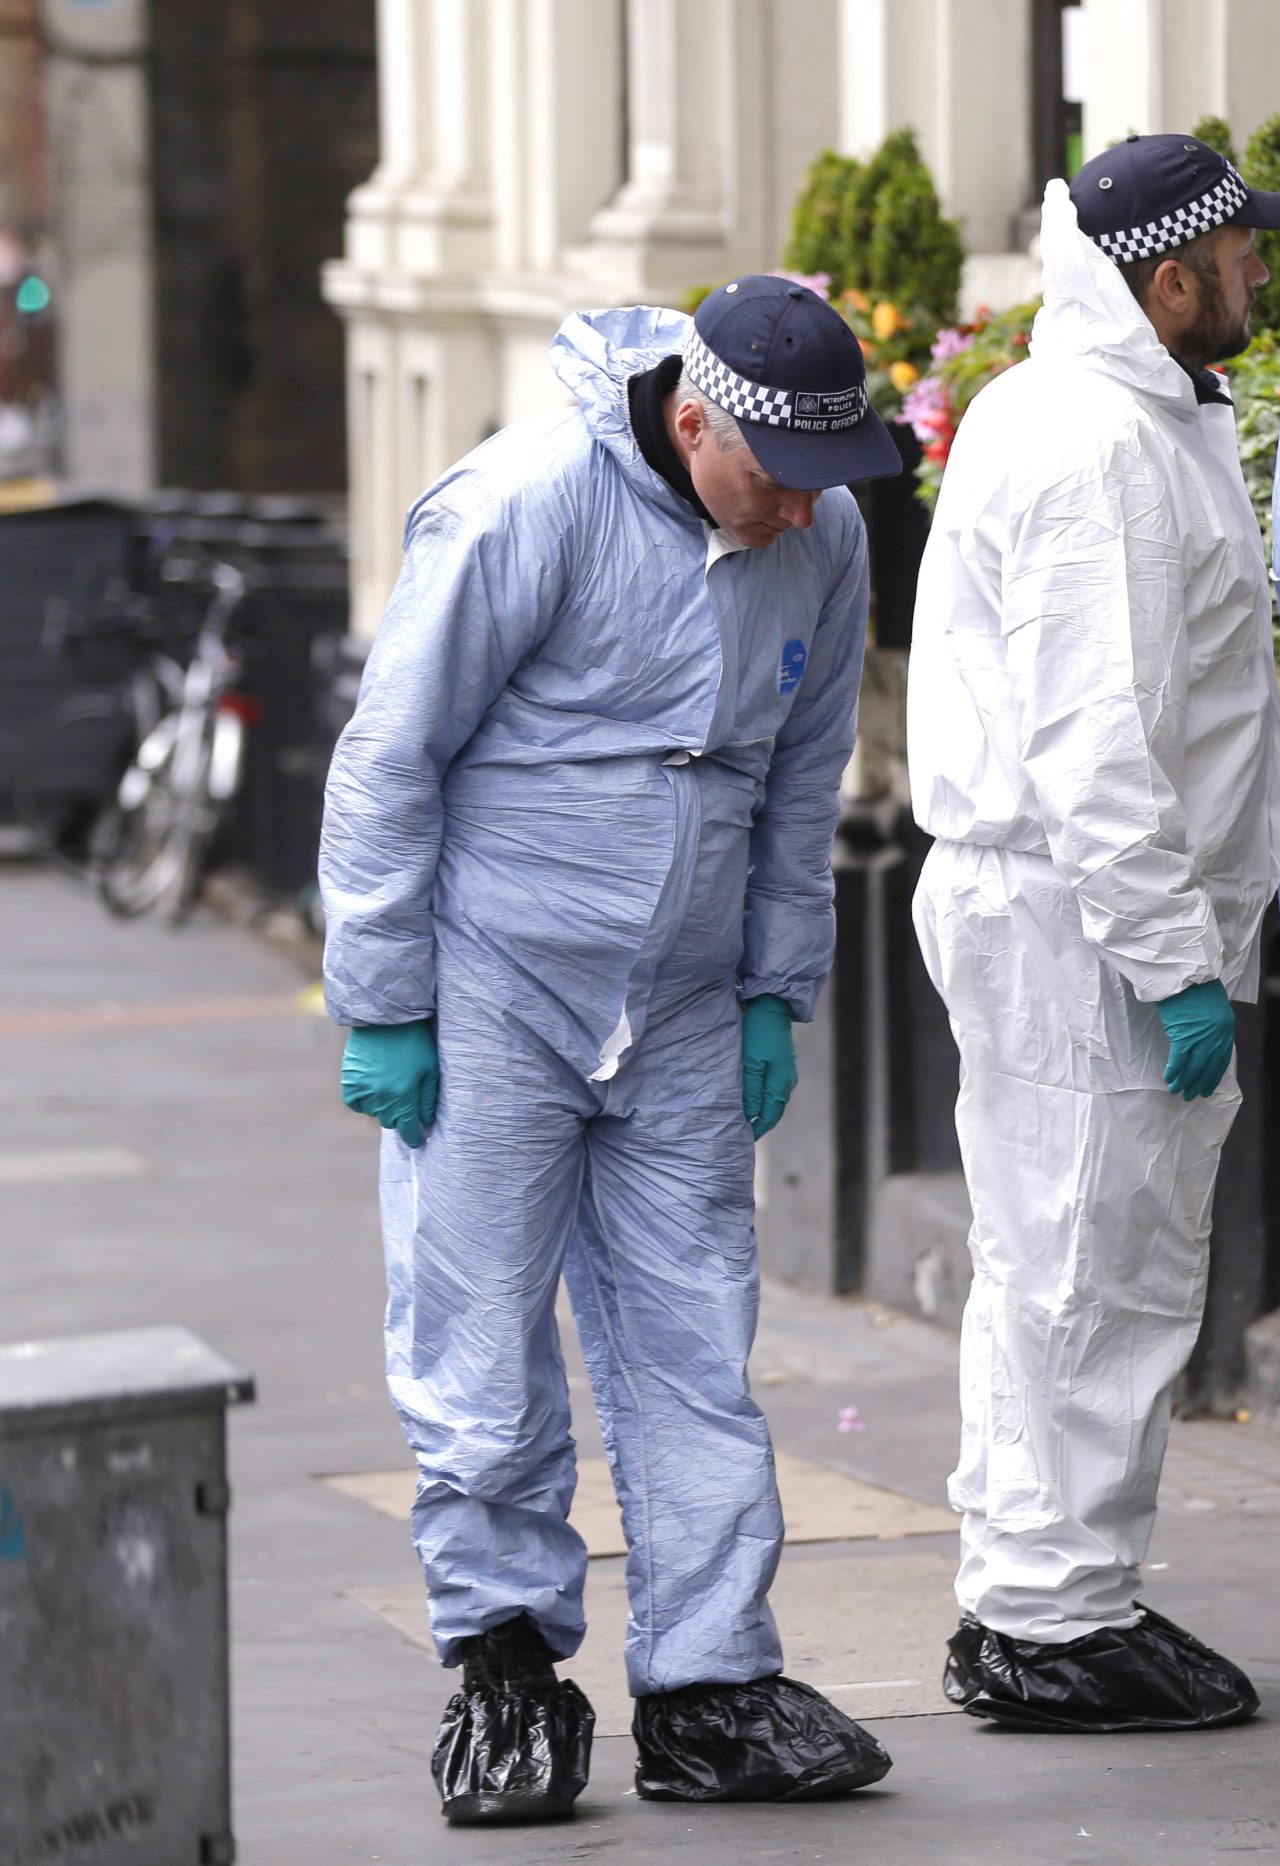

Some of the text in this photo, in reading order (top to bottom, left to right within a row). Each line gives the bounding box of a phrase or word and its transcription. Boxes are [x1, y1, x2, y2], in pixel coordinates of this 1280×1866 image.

[828, 401, 852, 412] POLICE
[794, 413, 859, 431] POLICE OFFICER
